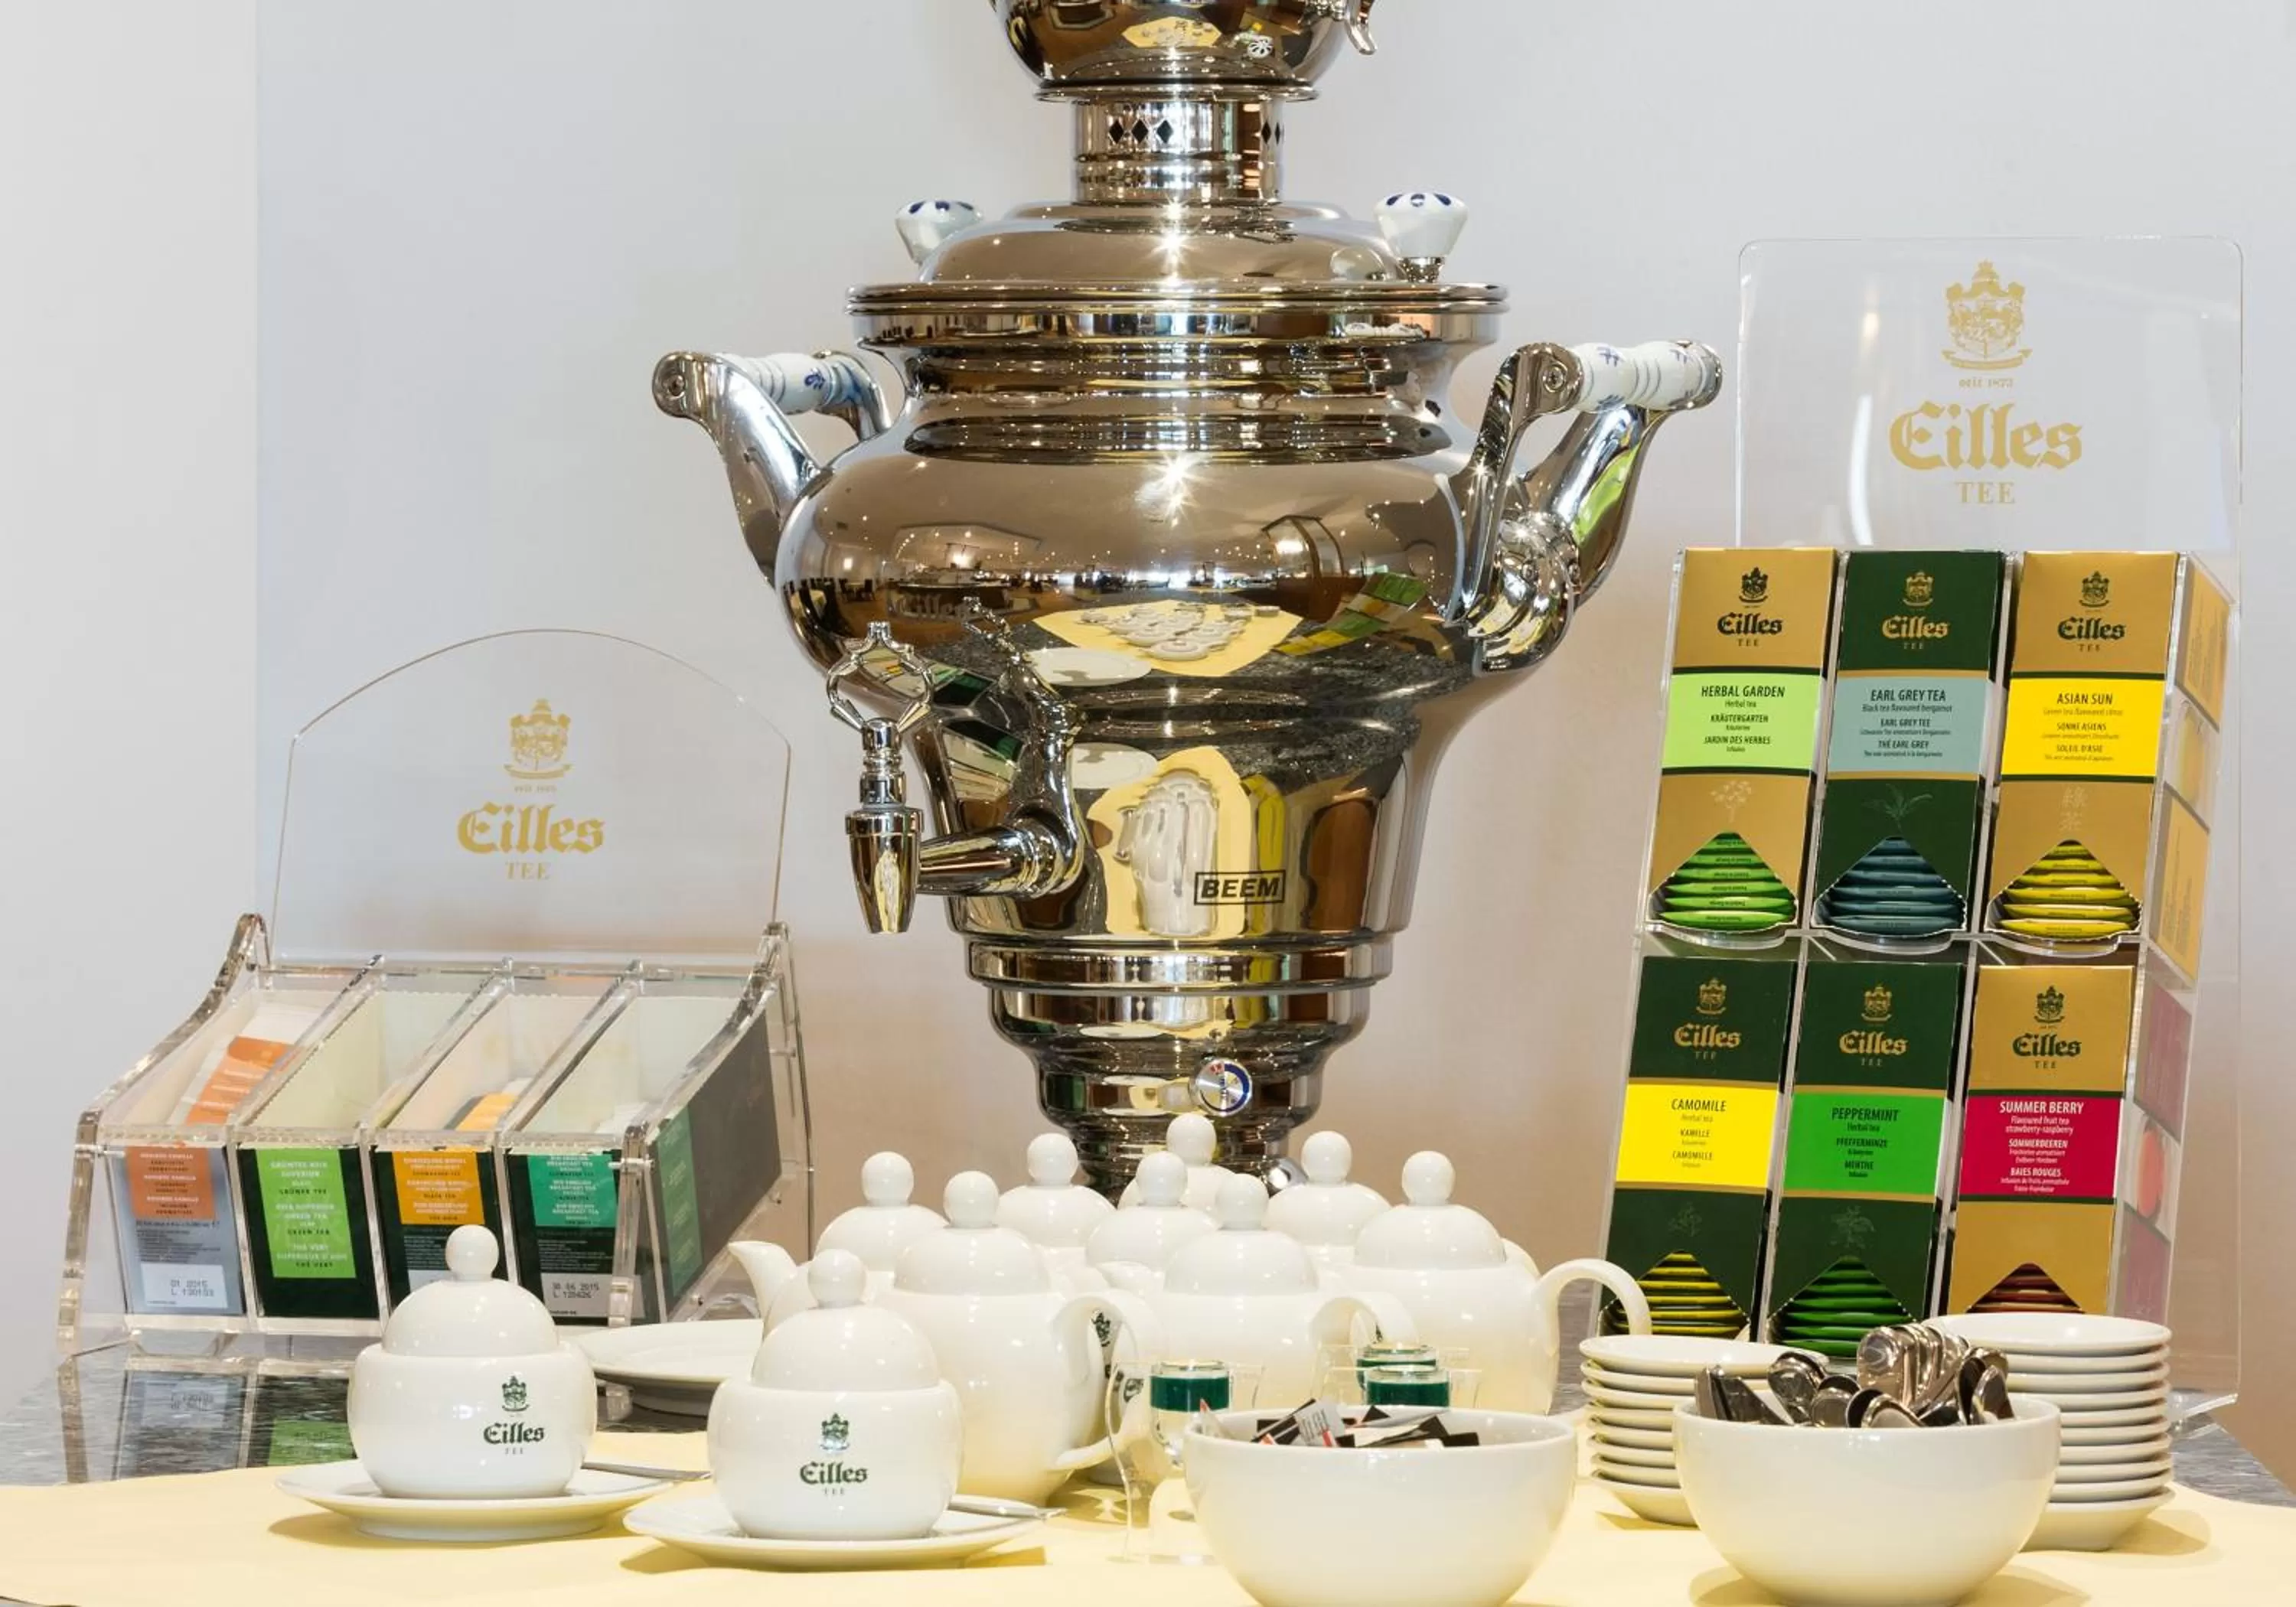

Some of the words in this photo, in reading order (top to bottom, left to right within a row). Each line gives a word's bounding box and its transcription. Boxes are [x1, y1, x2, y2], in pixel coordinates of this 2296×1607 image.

[1889, 400, 2082, 471] Eilles
[1955, 481, 2016, 504] TEE
[1717, 612, 1783, 635] Eilles
[1881, 615, 1950, 639] Eilles
[2057, 616, 2126, 641] Eilles
[2079, 644, 2101, 652] TEE
[1701, 685, 1740, 697] HERBAL
[1743, 685, 1786, 698] GARDEN
[1870, 689, 1895, 702] EARL
[1898, 689, 1926, 702] GREY
[1927, 689, 1946, 702] TEA
[2056, 693, 2089, 705] ASIAN
[2091, 693, 2113, 705] SUN
[457, 801, 605, 854] Eilles
[505, 862, 551, 880] TEE
[1201, 878, 1280, 898] BEEM
[1673, 1022, 1742, 1048] Eilles
[1839, 1030, 1908, 1055] Eilles
[2012, 1033, 2082, 1057] Eilles
[2034, 1061, 2057, 1069] TEE
[1671, 1098, 1727, 1112] CAMOMILE
[1831, 1107, 1901, 1121] PEPPERMINT
[1999, 1100, 2047, 1113] SUMMER
[2049, 1101, 2084, 1114] BERRY
[483, 1422, 545, 1445] Eilles
[799, 1461, 869, 1485] Eilles
